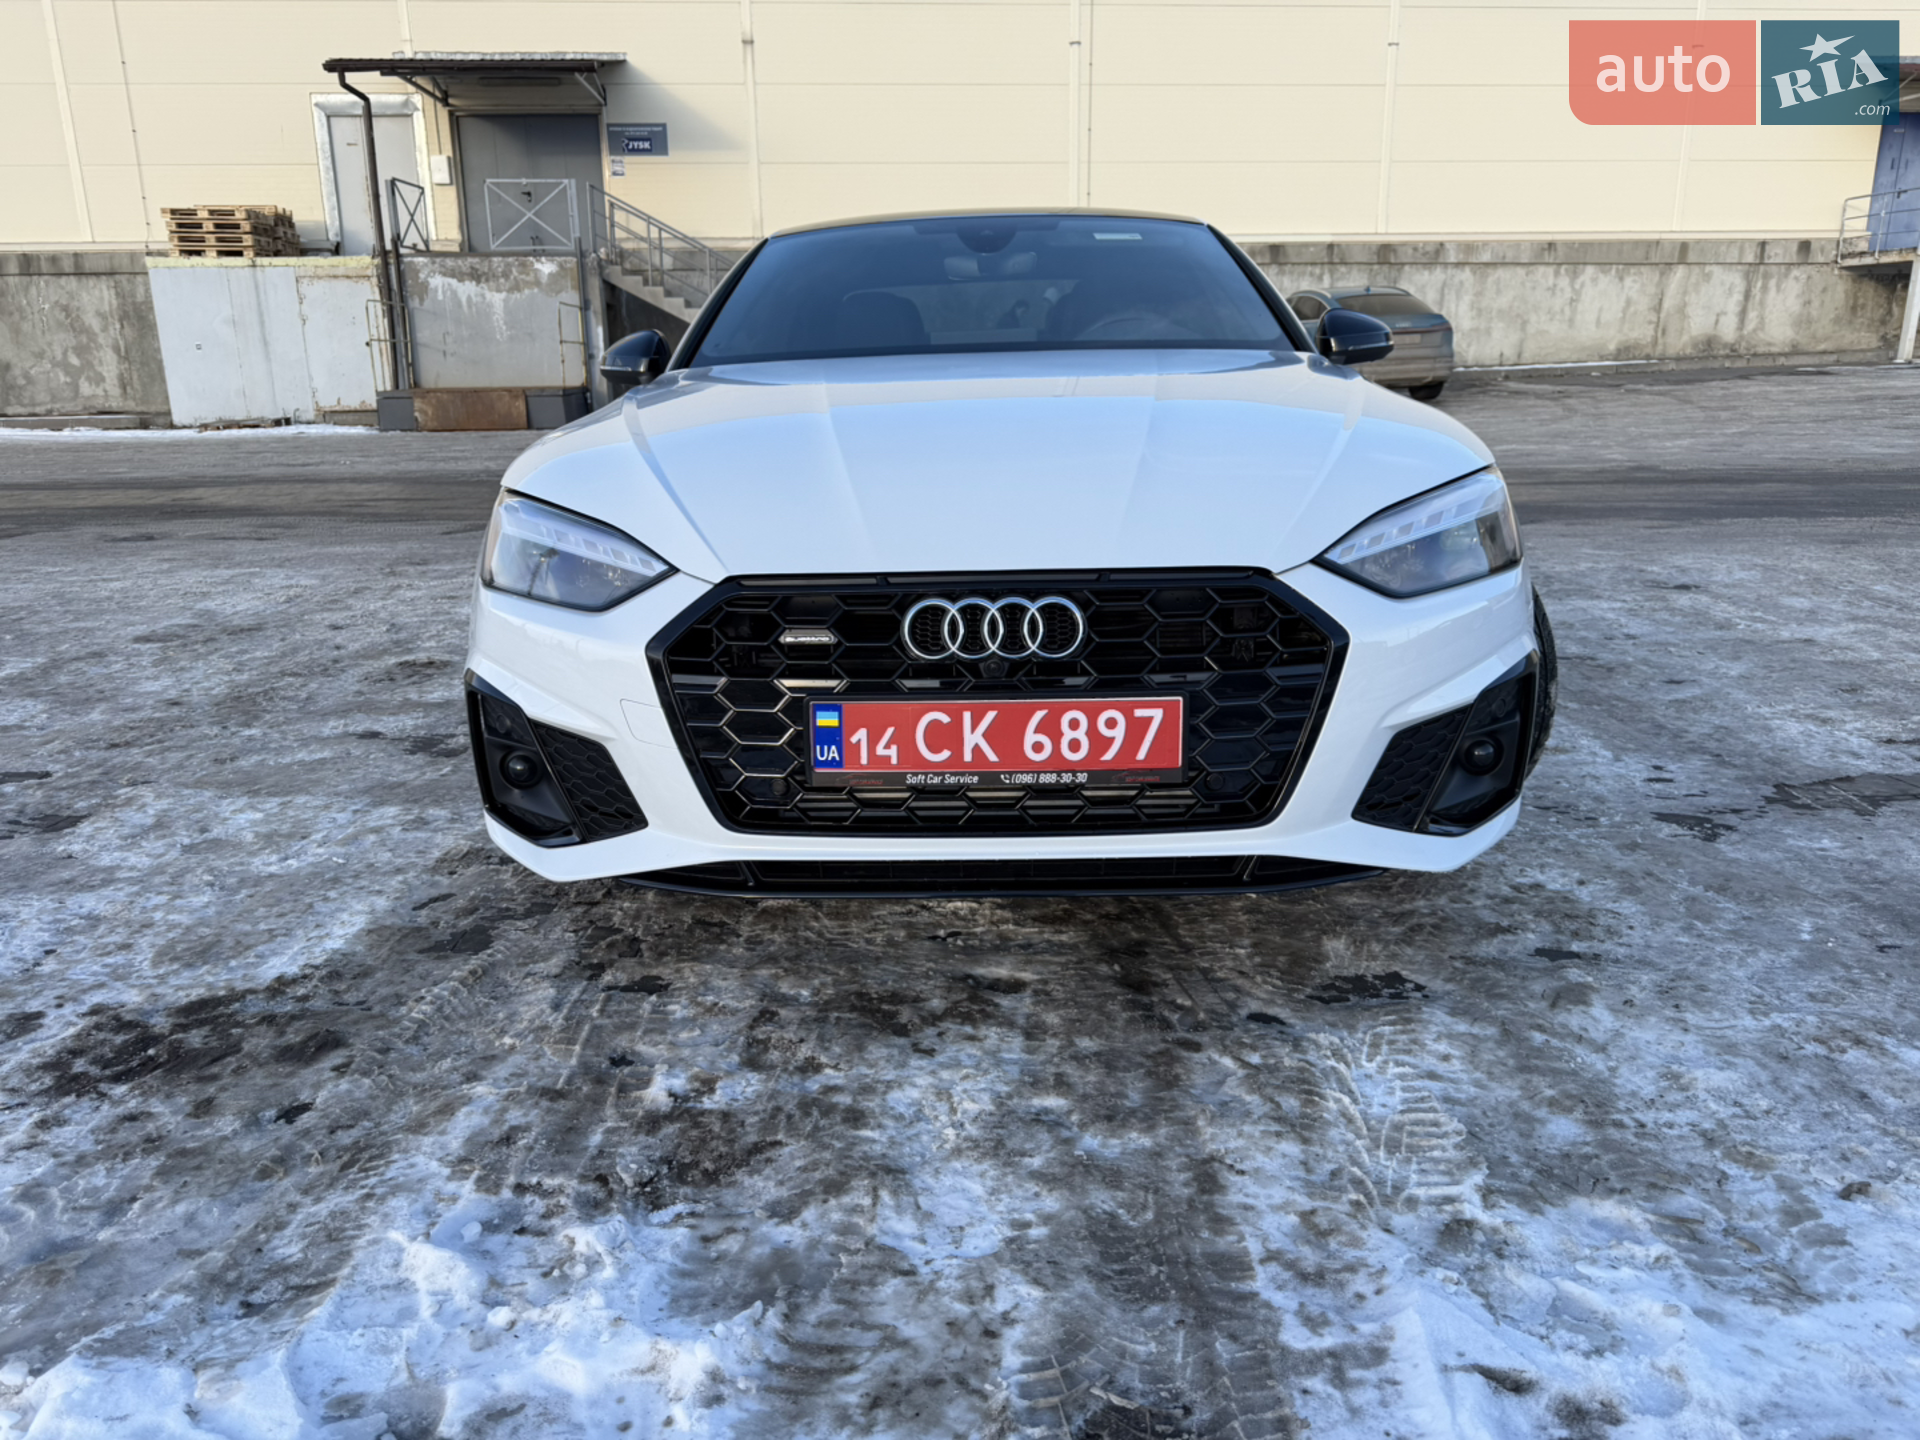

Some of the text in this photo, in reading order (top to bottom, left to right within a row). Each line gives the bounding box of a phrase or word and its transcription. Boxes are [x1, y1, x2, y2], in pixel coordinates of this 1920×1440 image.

[628, 141, 651, 149] JYSK
[850, 708, 1164, 765] 14 CK 6897
[816, 745, 840, 760] UA
[906, 772, 1088, 784] Soft Car Service (096) 888-30-30
